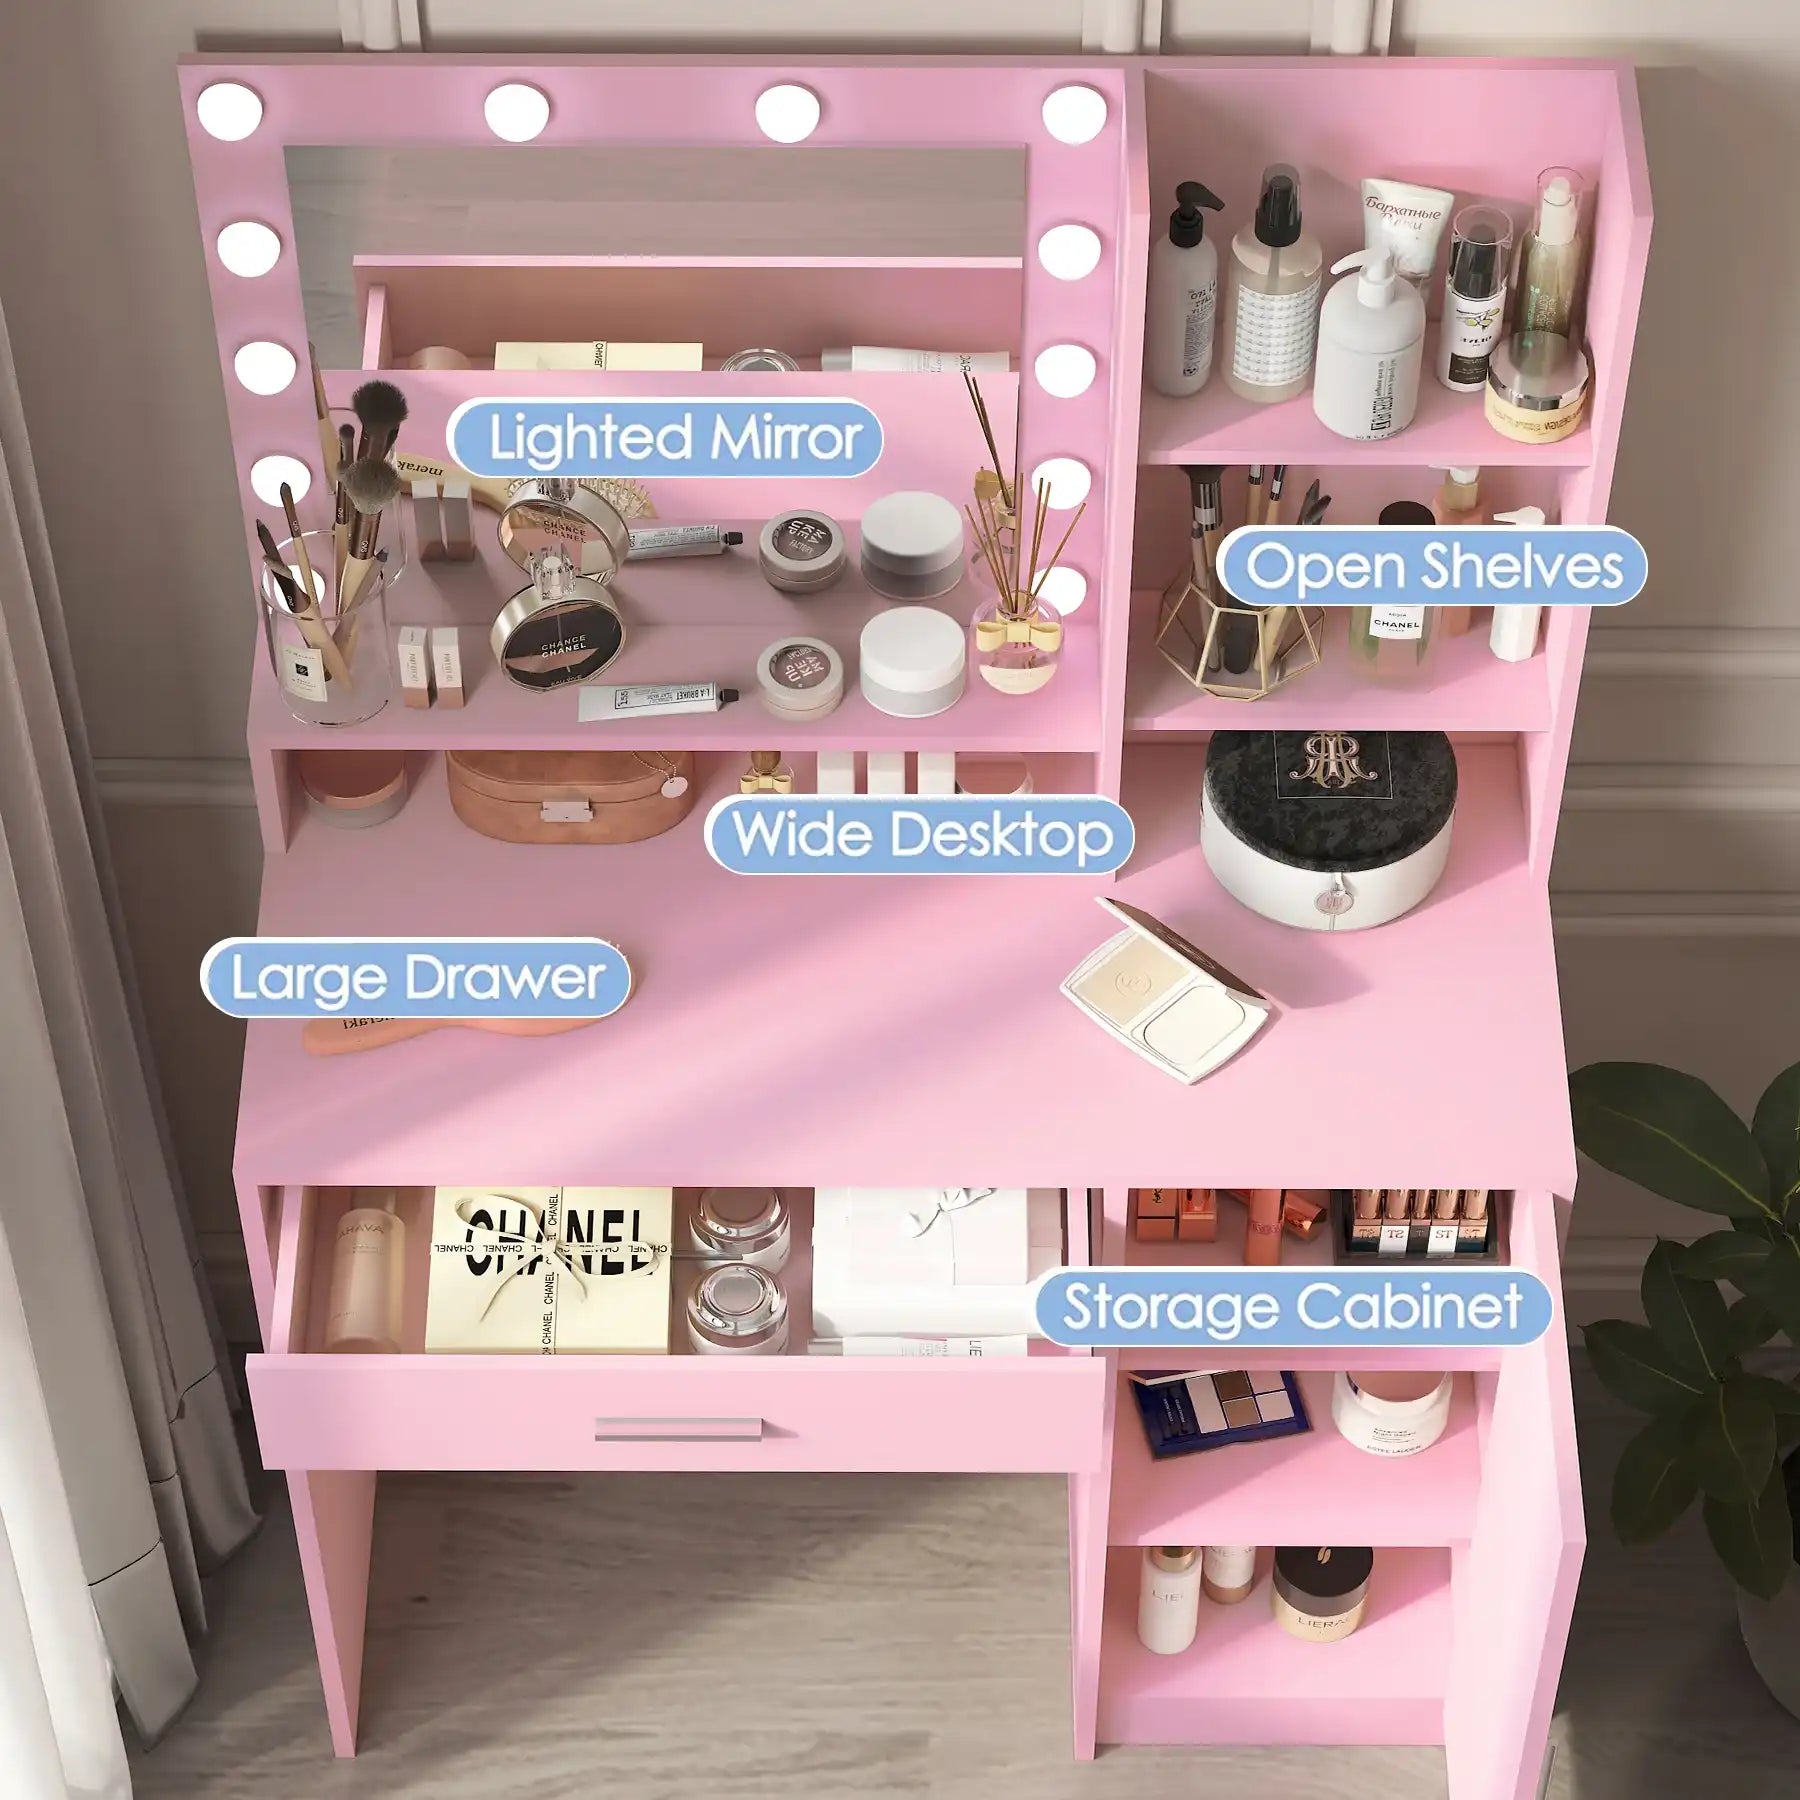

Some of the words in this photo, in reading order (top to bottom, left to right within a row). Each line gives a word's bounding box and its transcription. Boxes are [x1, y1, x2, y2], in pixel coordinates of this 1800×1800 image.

[1365, 196, 1441, 220] Бархатные
[1374, 619, 1420, 629] CHANEL
[541, 634, 587, 651] CHANCE
[541, 642, 587, 659] CHANEL
[547, 1193, 559, 1226] CHANEL
[434, 1244, 475, 1253] CHANEL
[482, 1244, 523, 1253] CHANEL
[544, 1271, 555, 1305] CHANEL
[543, 1311, 553, 1346] CHANEL
